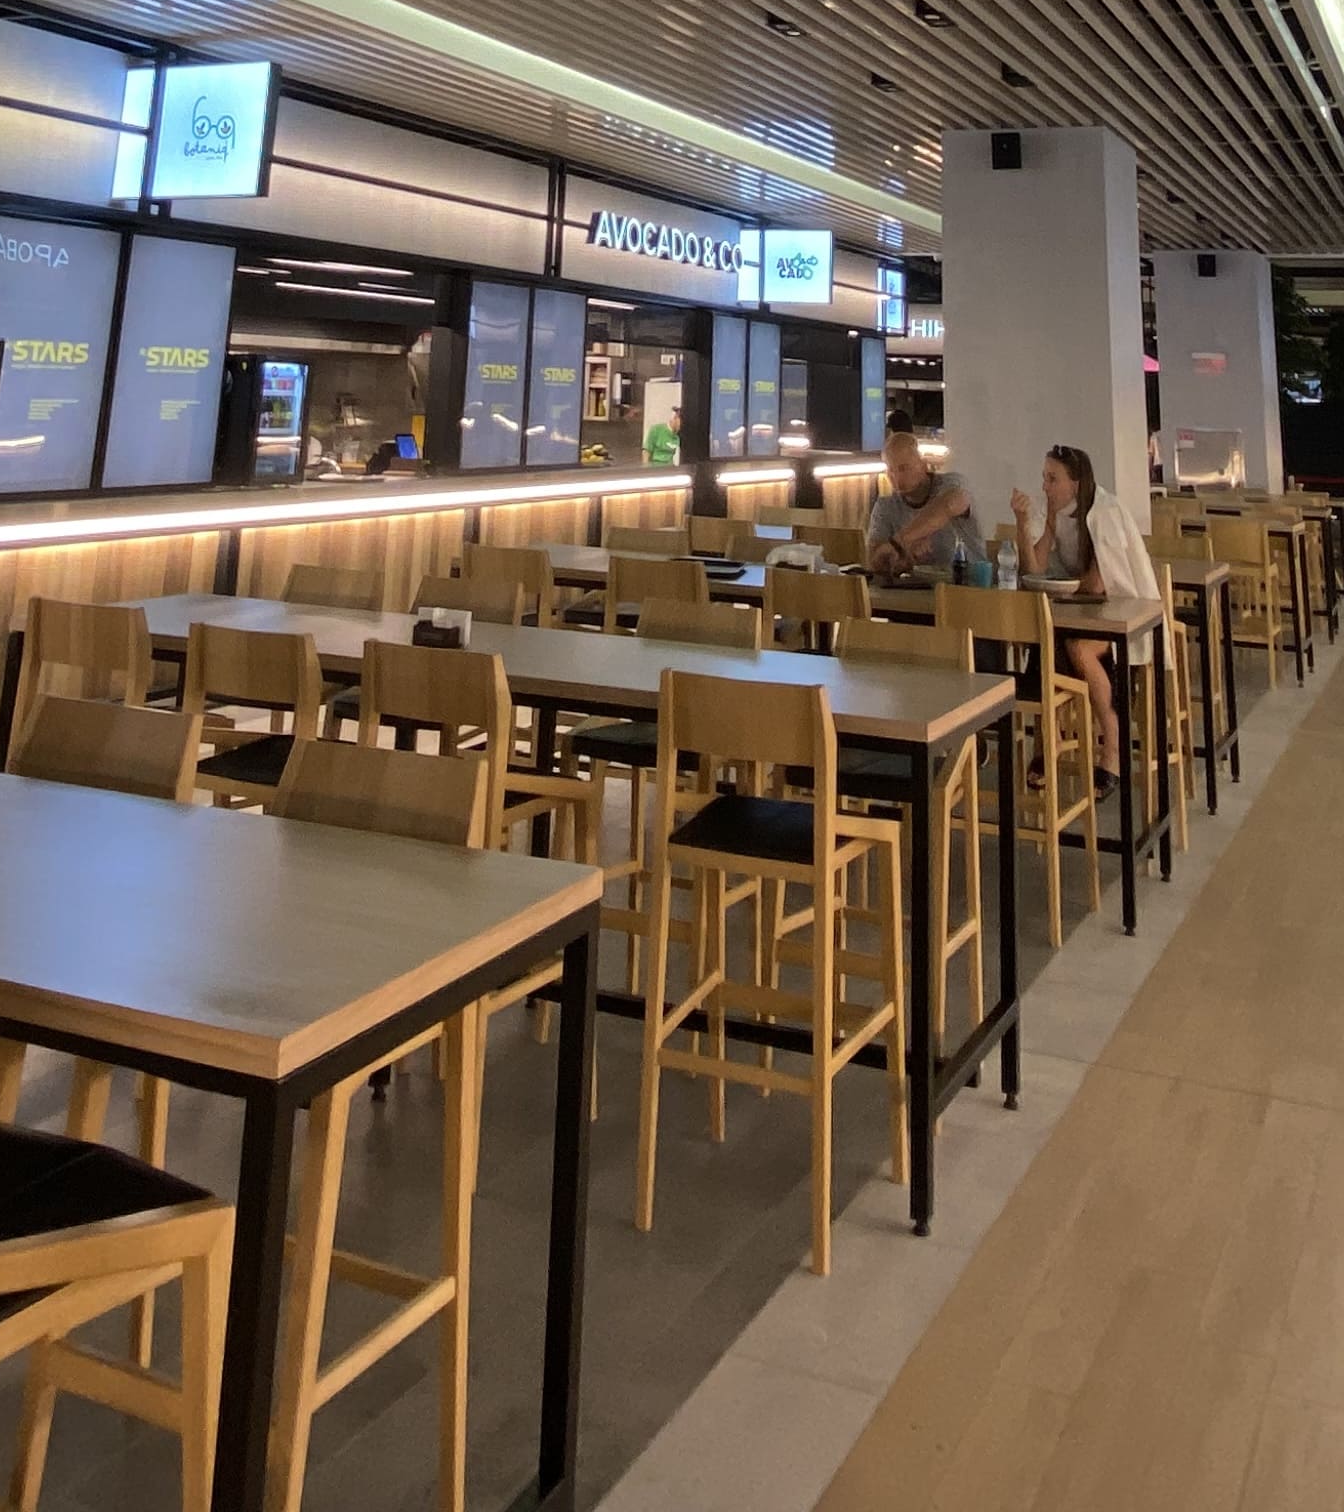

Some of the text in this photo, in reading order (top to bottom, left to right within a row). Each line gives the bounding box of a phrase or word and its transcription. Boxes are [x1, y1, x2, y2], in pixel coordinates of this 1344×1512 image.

[594, 210, 700, 264] AVOCADO
[719, 240, 744, 273] CO
[11, 340, 89, 364] STARS
[145, 347, 210, 368] STARS
